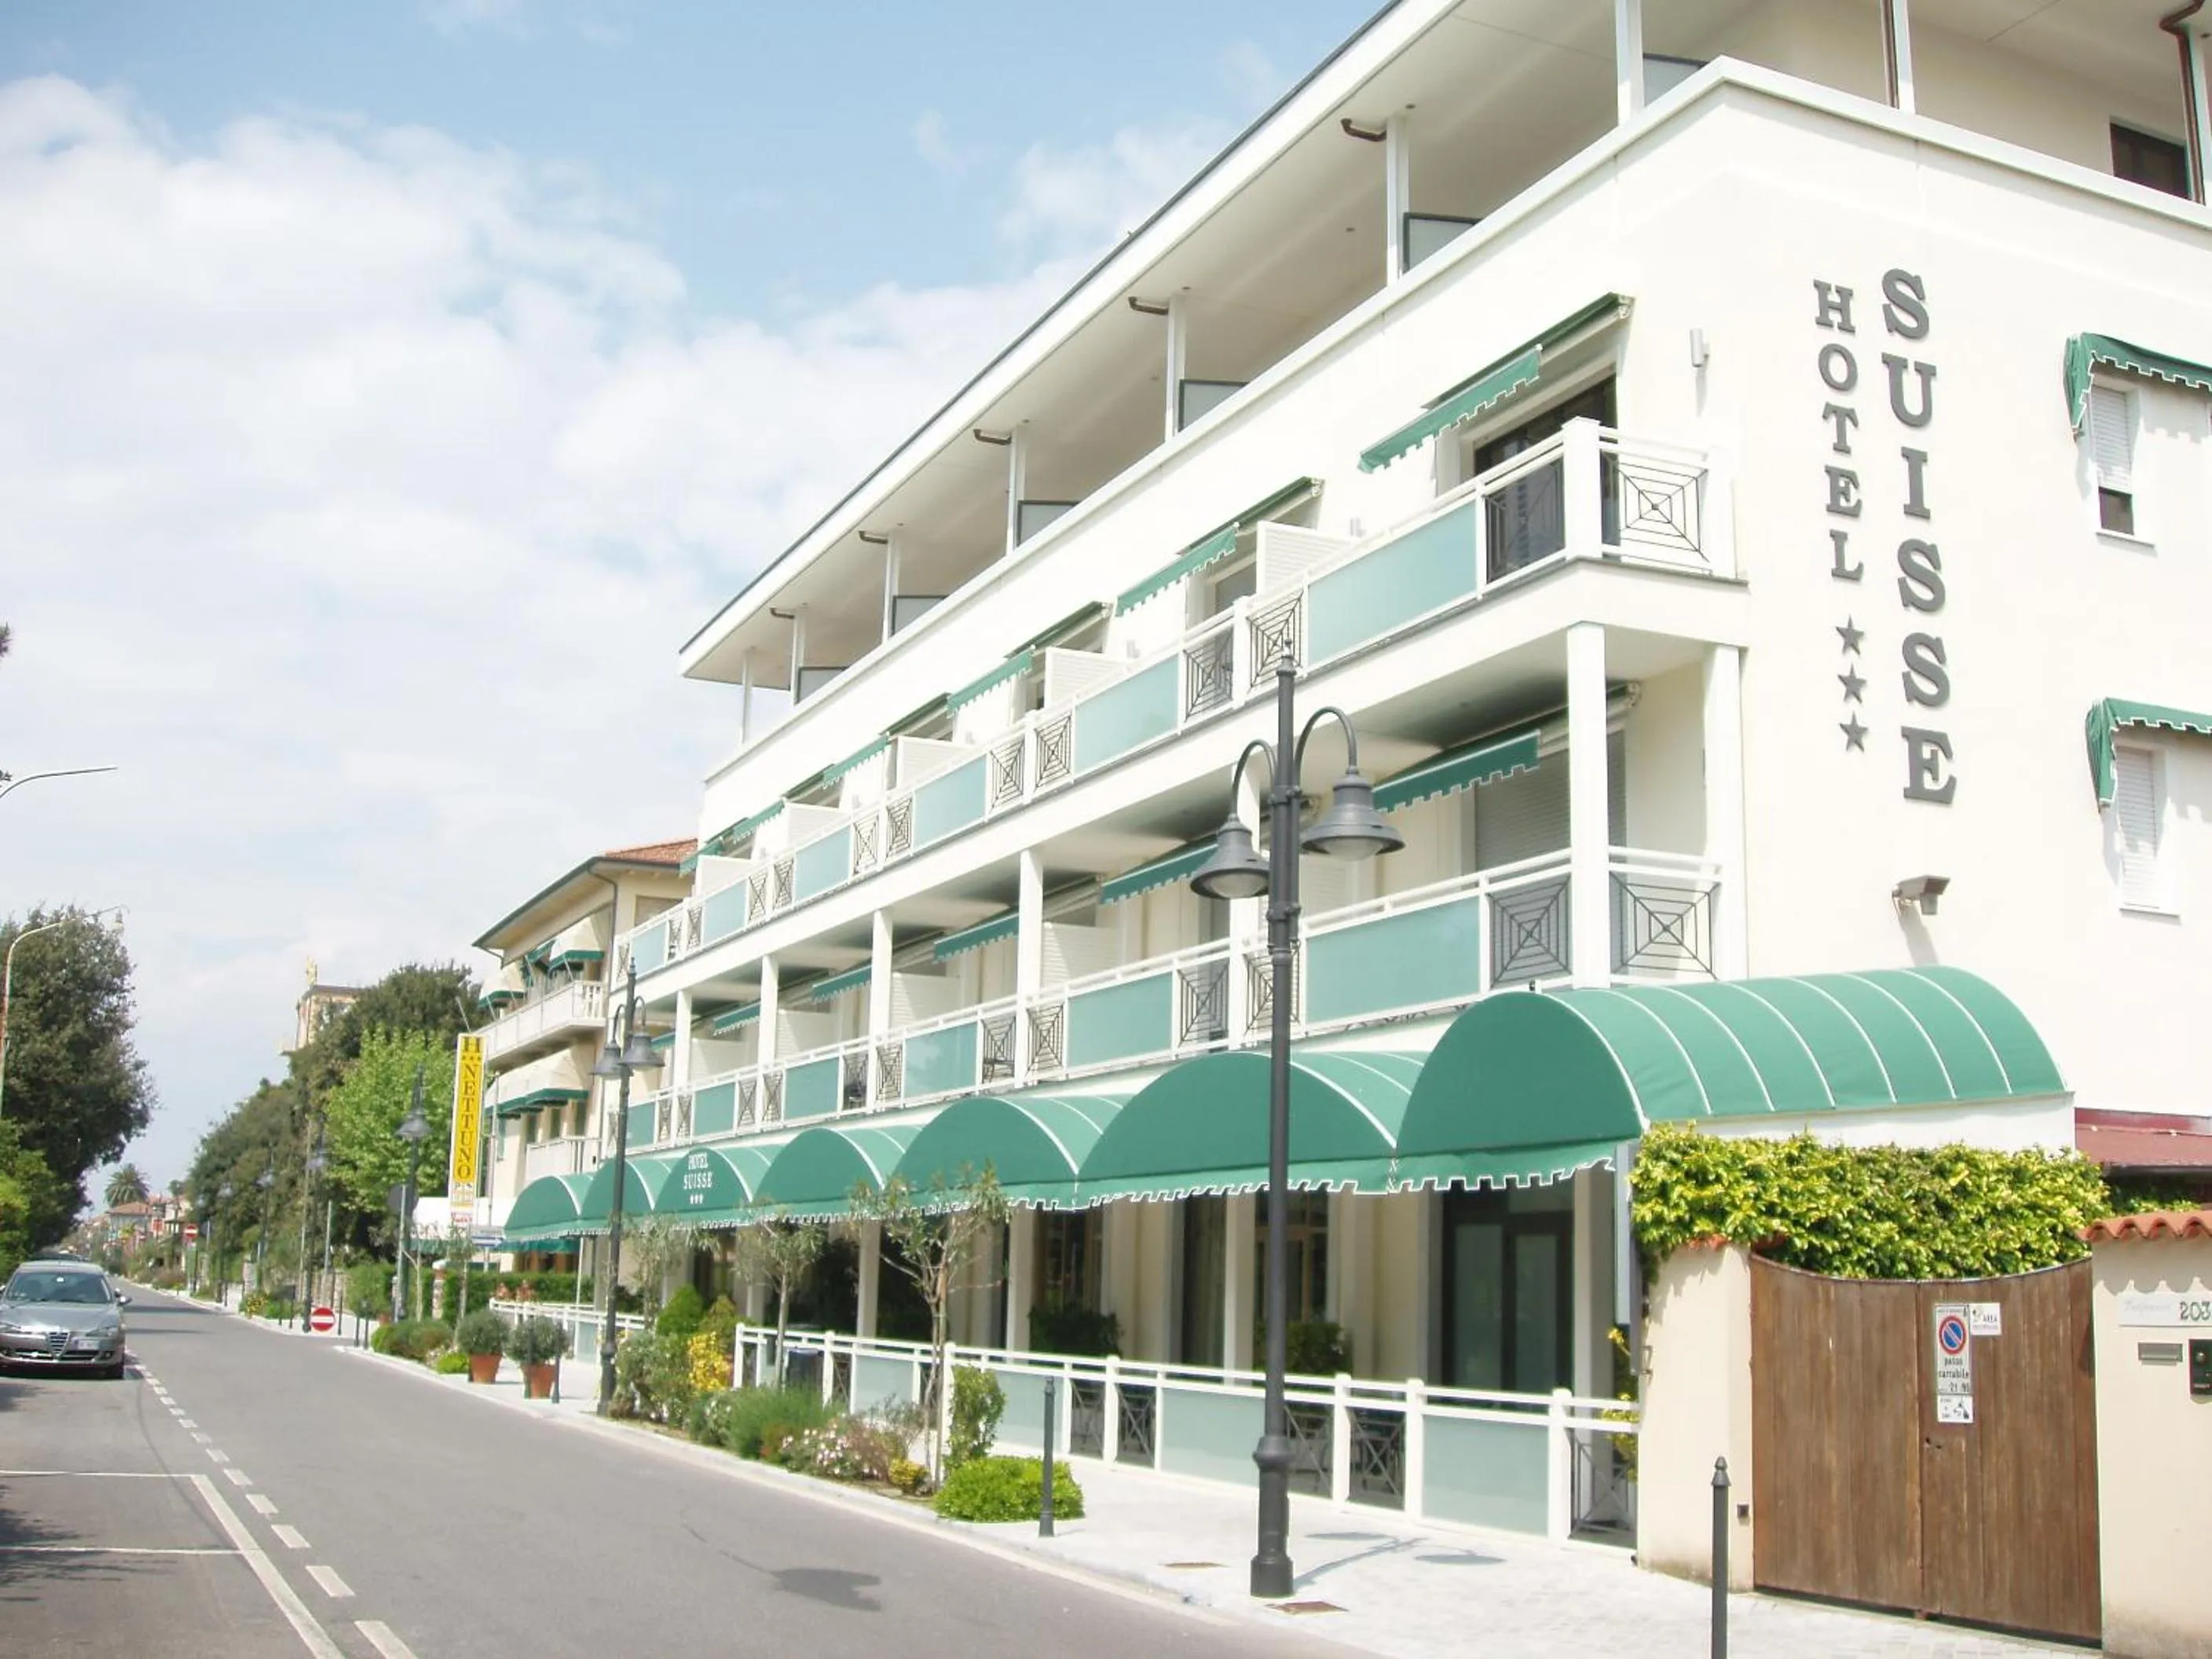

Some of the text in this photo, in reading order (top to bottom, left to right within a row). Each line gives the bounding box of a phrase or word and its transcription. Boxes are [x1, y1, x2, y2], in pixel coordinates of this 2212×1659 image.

[1814, 279, 1863, 580] HOTEL
[1881, 268, 1957, 805] SUISSE
[458, 1064, 478, 1177] NETTUNO
[688, 1152, 709, 1170] HOTEL
[683, 1171, 712, 1190] SUISSE
